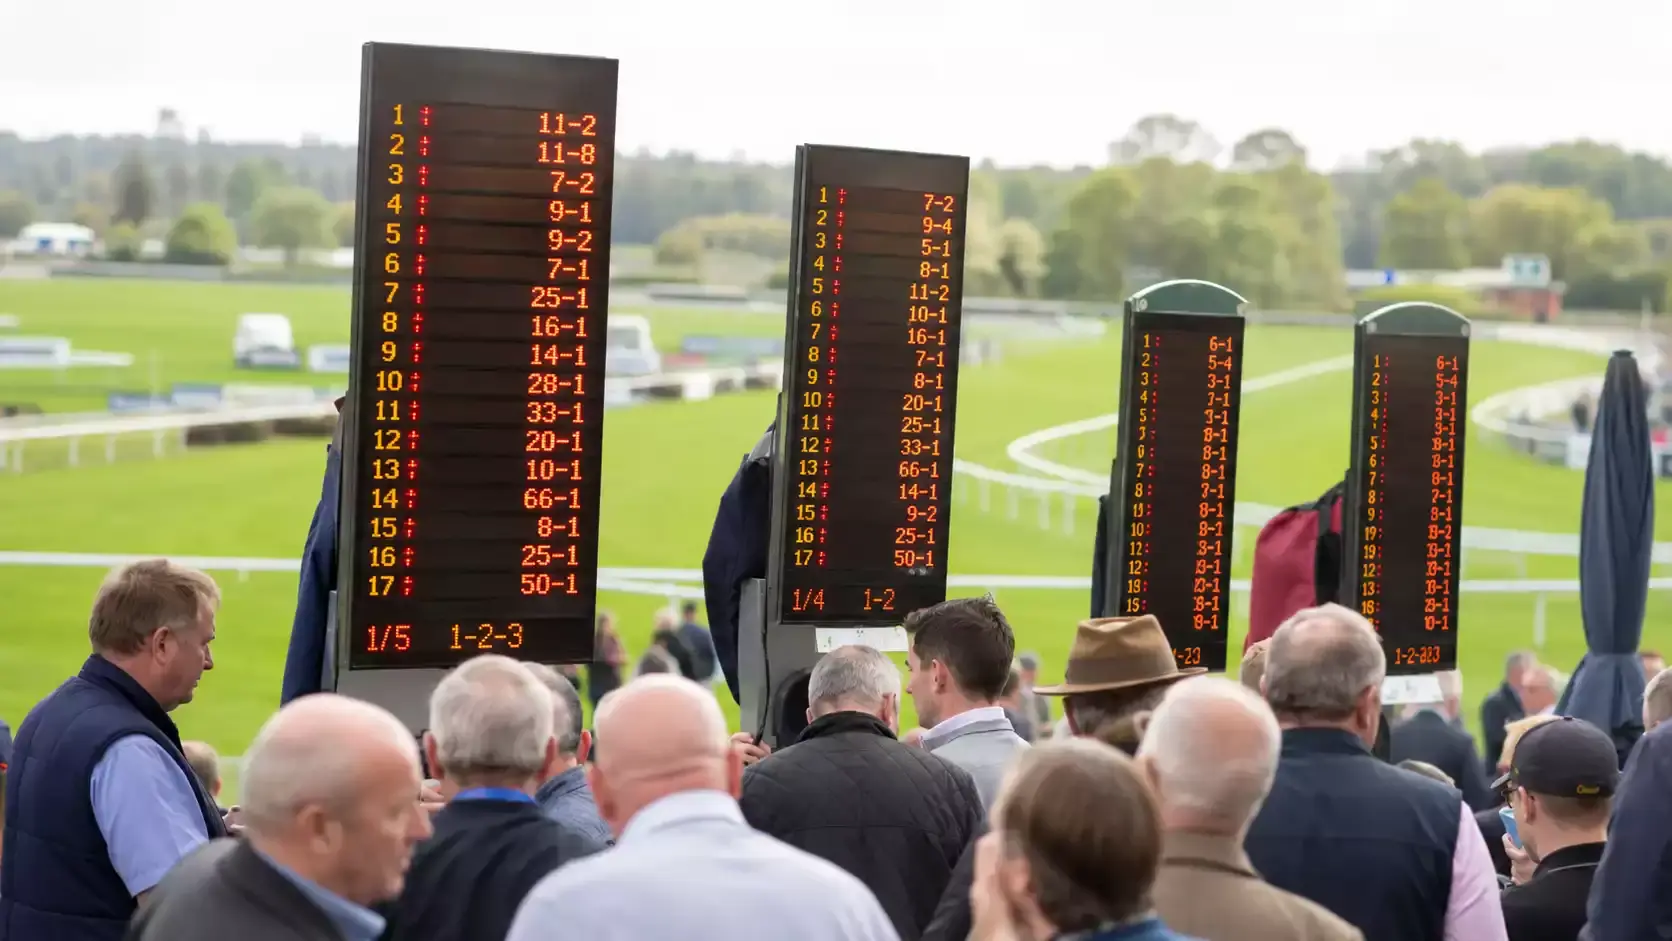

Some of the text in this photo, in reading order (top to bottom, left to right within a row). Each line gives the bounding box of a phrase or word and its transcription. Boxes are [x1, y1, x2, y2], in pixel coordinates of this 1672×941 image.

[392, 103, 597, 137] 1 11-2
[388, 133, 596, 165] 2 11-8
[387, 163, 595, 194] 3 7-2
[386, 193, 592, 223] 4 9-1
[818, 186, 954, 213] 1 7-2
[816, 209, 953, 235] 2 9-4
[385, 222, 593, 252] 5 9-2
[815, 232, 951, 257] 3 5-1
[384, 252, 590, 281] 6 7-1
[813, 255, 950, 280] 4 8-1
[384, 281, 589, 309] 7 25-1
[812, 277, 950, 302] 5 11-2
[811, 300, 947, 324] 6 10-1
[382, 311, 587, 338] 8 16-1
[810, 323, 946, 346] 7 16-1
[381, 341, 586, 366] 9 14-1
[1143, 334, 1233, 353] 1 6-1
[808, 346, 945, 368] 8 7-1
[1141, 352, 1232, 370] 2 5-4
[1373, 354, 1459, 371] 1 6-1
[376, 370, 585, 395] 10 28-1
[807, 368, 944, 390] 9 8-1
[1140, 371, 1231, 389] 3 3-1
[1372, 372, 1458, 389] 2 5-4
[803, 391, 942, 412] 10 20-1
[1140, 390, 1149, 404] 4
[1371, 390, 1457, 406] 3 3-1
[376, 399, 584, 424] 11 33-1
[1139, 408, 1147, 423] 5
[1370, 408, 1379, 421] 4
[801, 414, 941, 434] 11 25-1
[374, 429, 583, 452] 12 20-1
[800, 437, 940, 456] 12 33-1
[1369, 436, 1378, 451] 5
[372, 458, 582, 481] 13 10-1
[799, 459, 939, 478] 13 66-1
[1369, 453, 1377, 468] 6
[1201, 463, 1225, 480] 8-1
[1368, 471, 1454, 486] 7 8-1
[372, 487, 581, 509] 14 66-1
[798, 481, 937, 500] 14 14-1
[1134, 482, 1144, 498] 8
[1368, 489, 1376, 505] 8
[796, 504, 937, 522] 15 9-2
[1367, 507, 1376, 522] 9
[370, 516, 580, 538] 15 8-1
[795, 527, 935, 545] 16 25-1
[1131, 522, 1145, 537] 10
[370, 544, 578, 567] 16 25-1
[794, 549, 934, 567] 17 50-1
[1129, 541, 1143, 556] 12
[1128, 559, 1143, 575] 12
[1362, 562, 1376, 578] 12
[368, 573, 577, 596] 17 50-1
[1361, 581, 1376, 597] 13
[792, 588, 895, 611] 1/4 1-2
[367, 623, 523, 651] 1/5 1-2-3
[1172, 647, 1201, 665] -23
